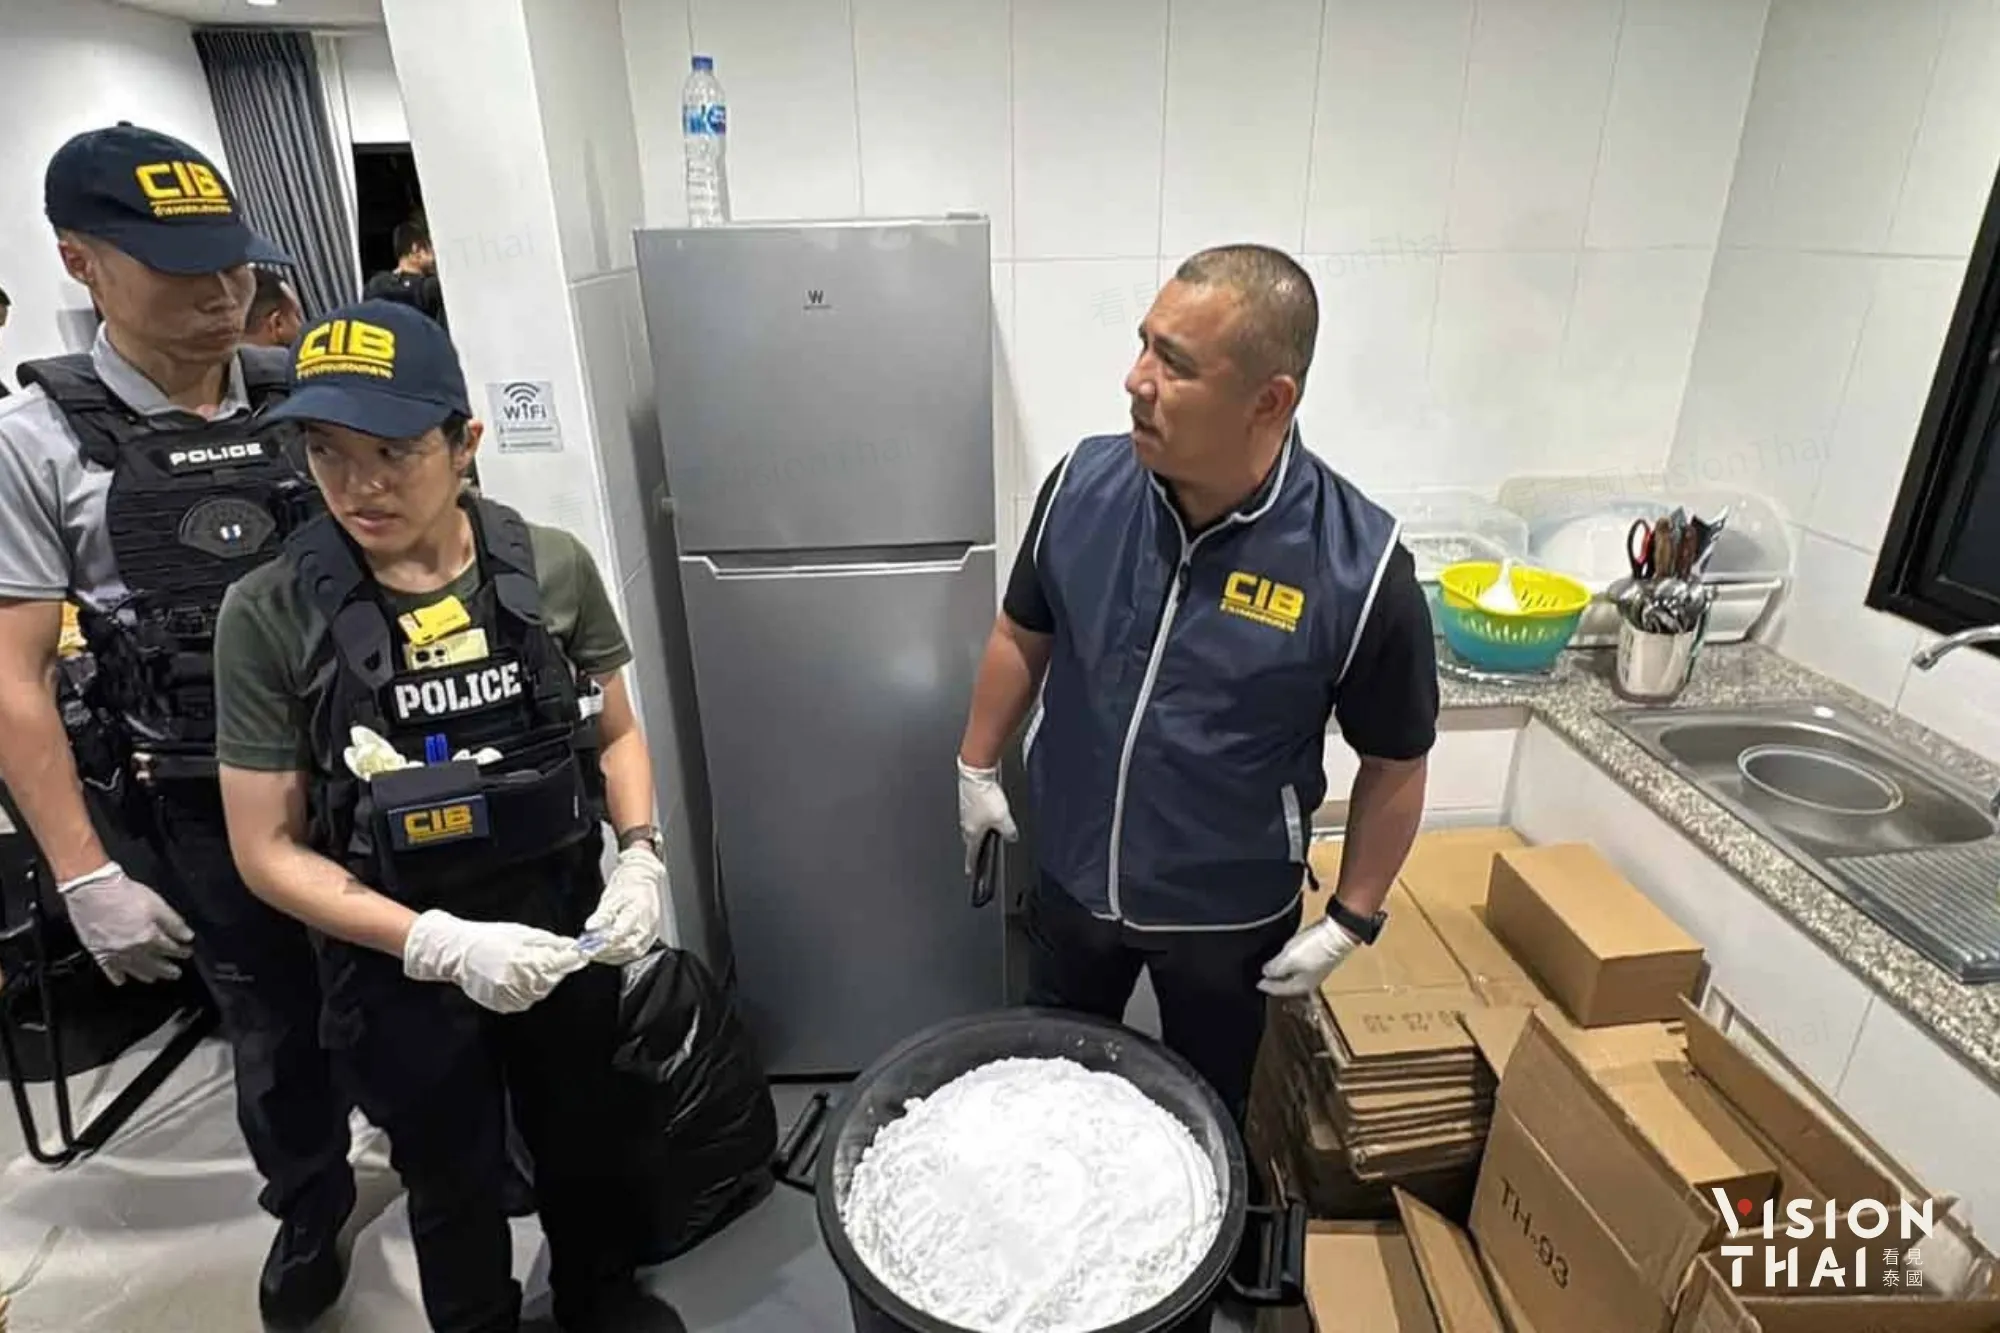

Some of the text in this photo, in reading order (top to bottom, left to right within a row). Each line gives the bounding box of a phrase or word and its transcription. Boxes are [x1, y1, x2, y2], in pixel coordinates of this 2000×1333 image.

[135, 160, 225, 198] CIB
[298, 319, 396, 360] CIB
[169, 443, 263, 466] POLICE
[1224, 571, 1304, 619] CIB
[394, 661, 522, 719] POLICE
[404, 804, 472, 836] CIB
